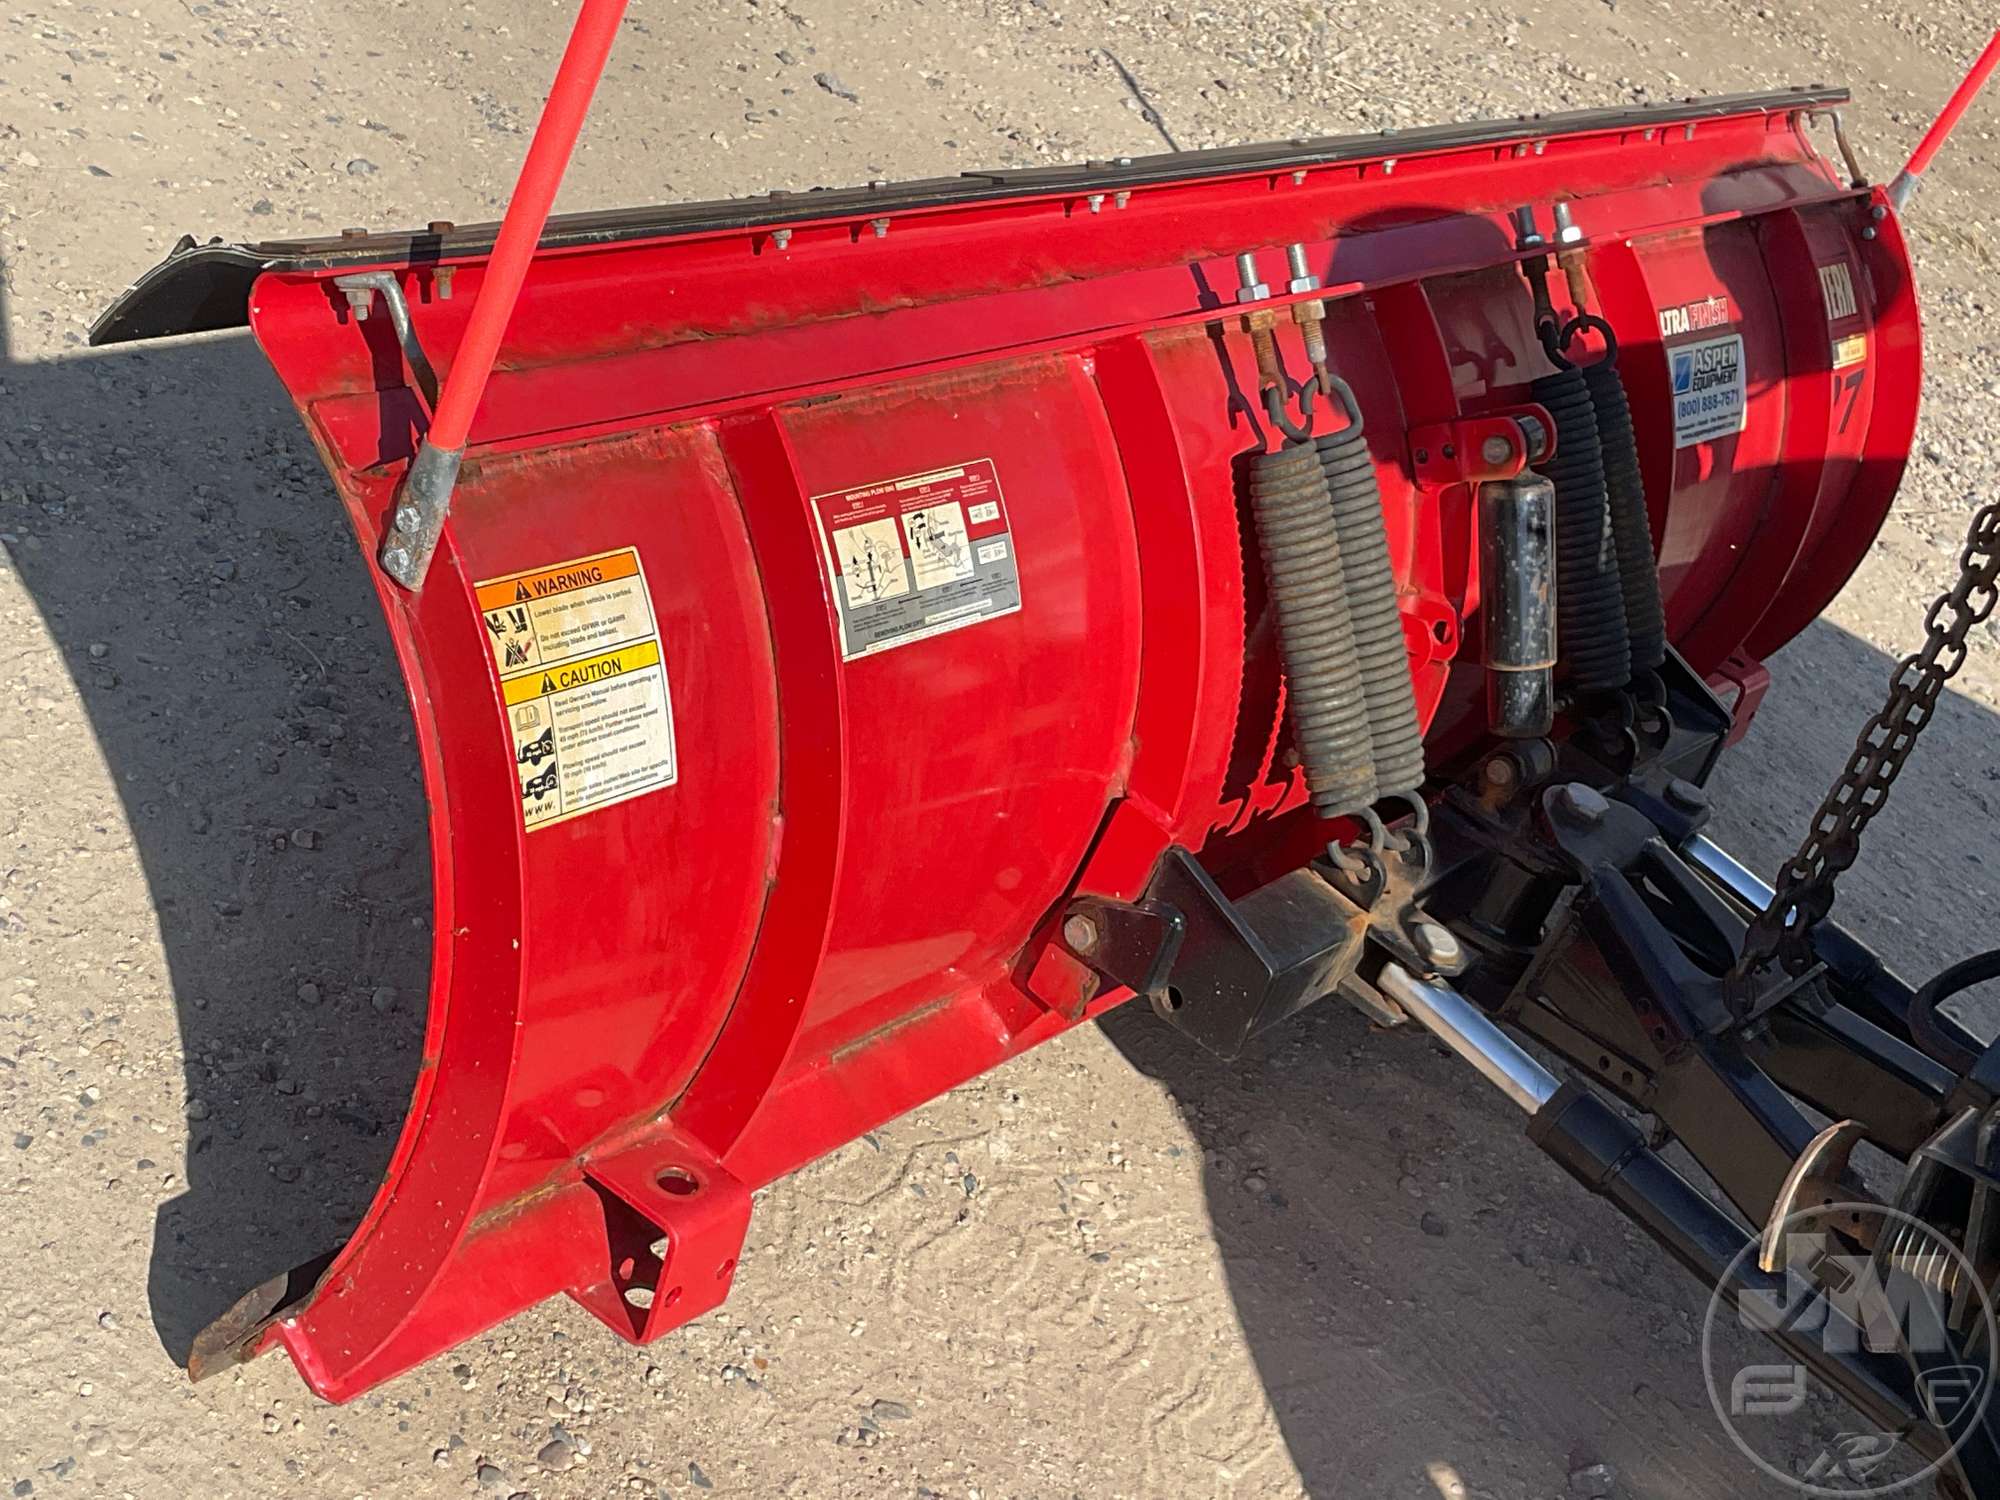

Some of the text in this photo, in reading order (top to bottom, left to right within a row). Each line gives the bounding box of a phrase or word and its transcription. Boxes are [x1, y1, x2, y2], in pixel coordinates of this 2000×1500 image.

[1659, 296, 1729, 337] LTRA FINISH
[1694, 341, 1738, 376] ASPEN
[1692, 368, 1738, 392] EQUIPMENT
[1678, 397, 1701, 420] (800)
[532, 567, 603, 596] WARNING
[534, 608, 552, 618] Lower
[552, 604, 569, 613] blade
[570, 600, 586, 608] when
[586, 594, 606, 604] vehicle
[540, 634, 549, 642] Do
[550, 632, 560, 640] not
[560, 626, 581, 636] exceed
[570, 634, 586, 644] blade
[587, 632, 598, 641] and
[560, 657, 622, 688] CAUTION
